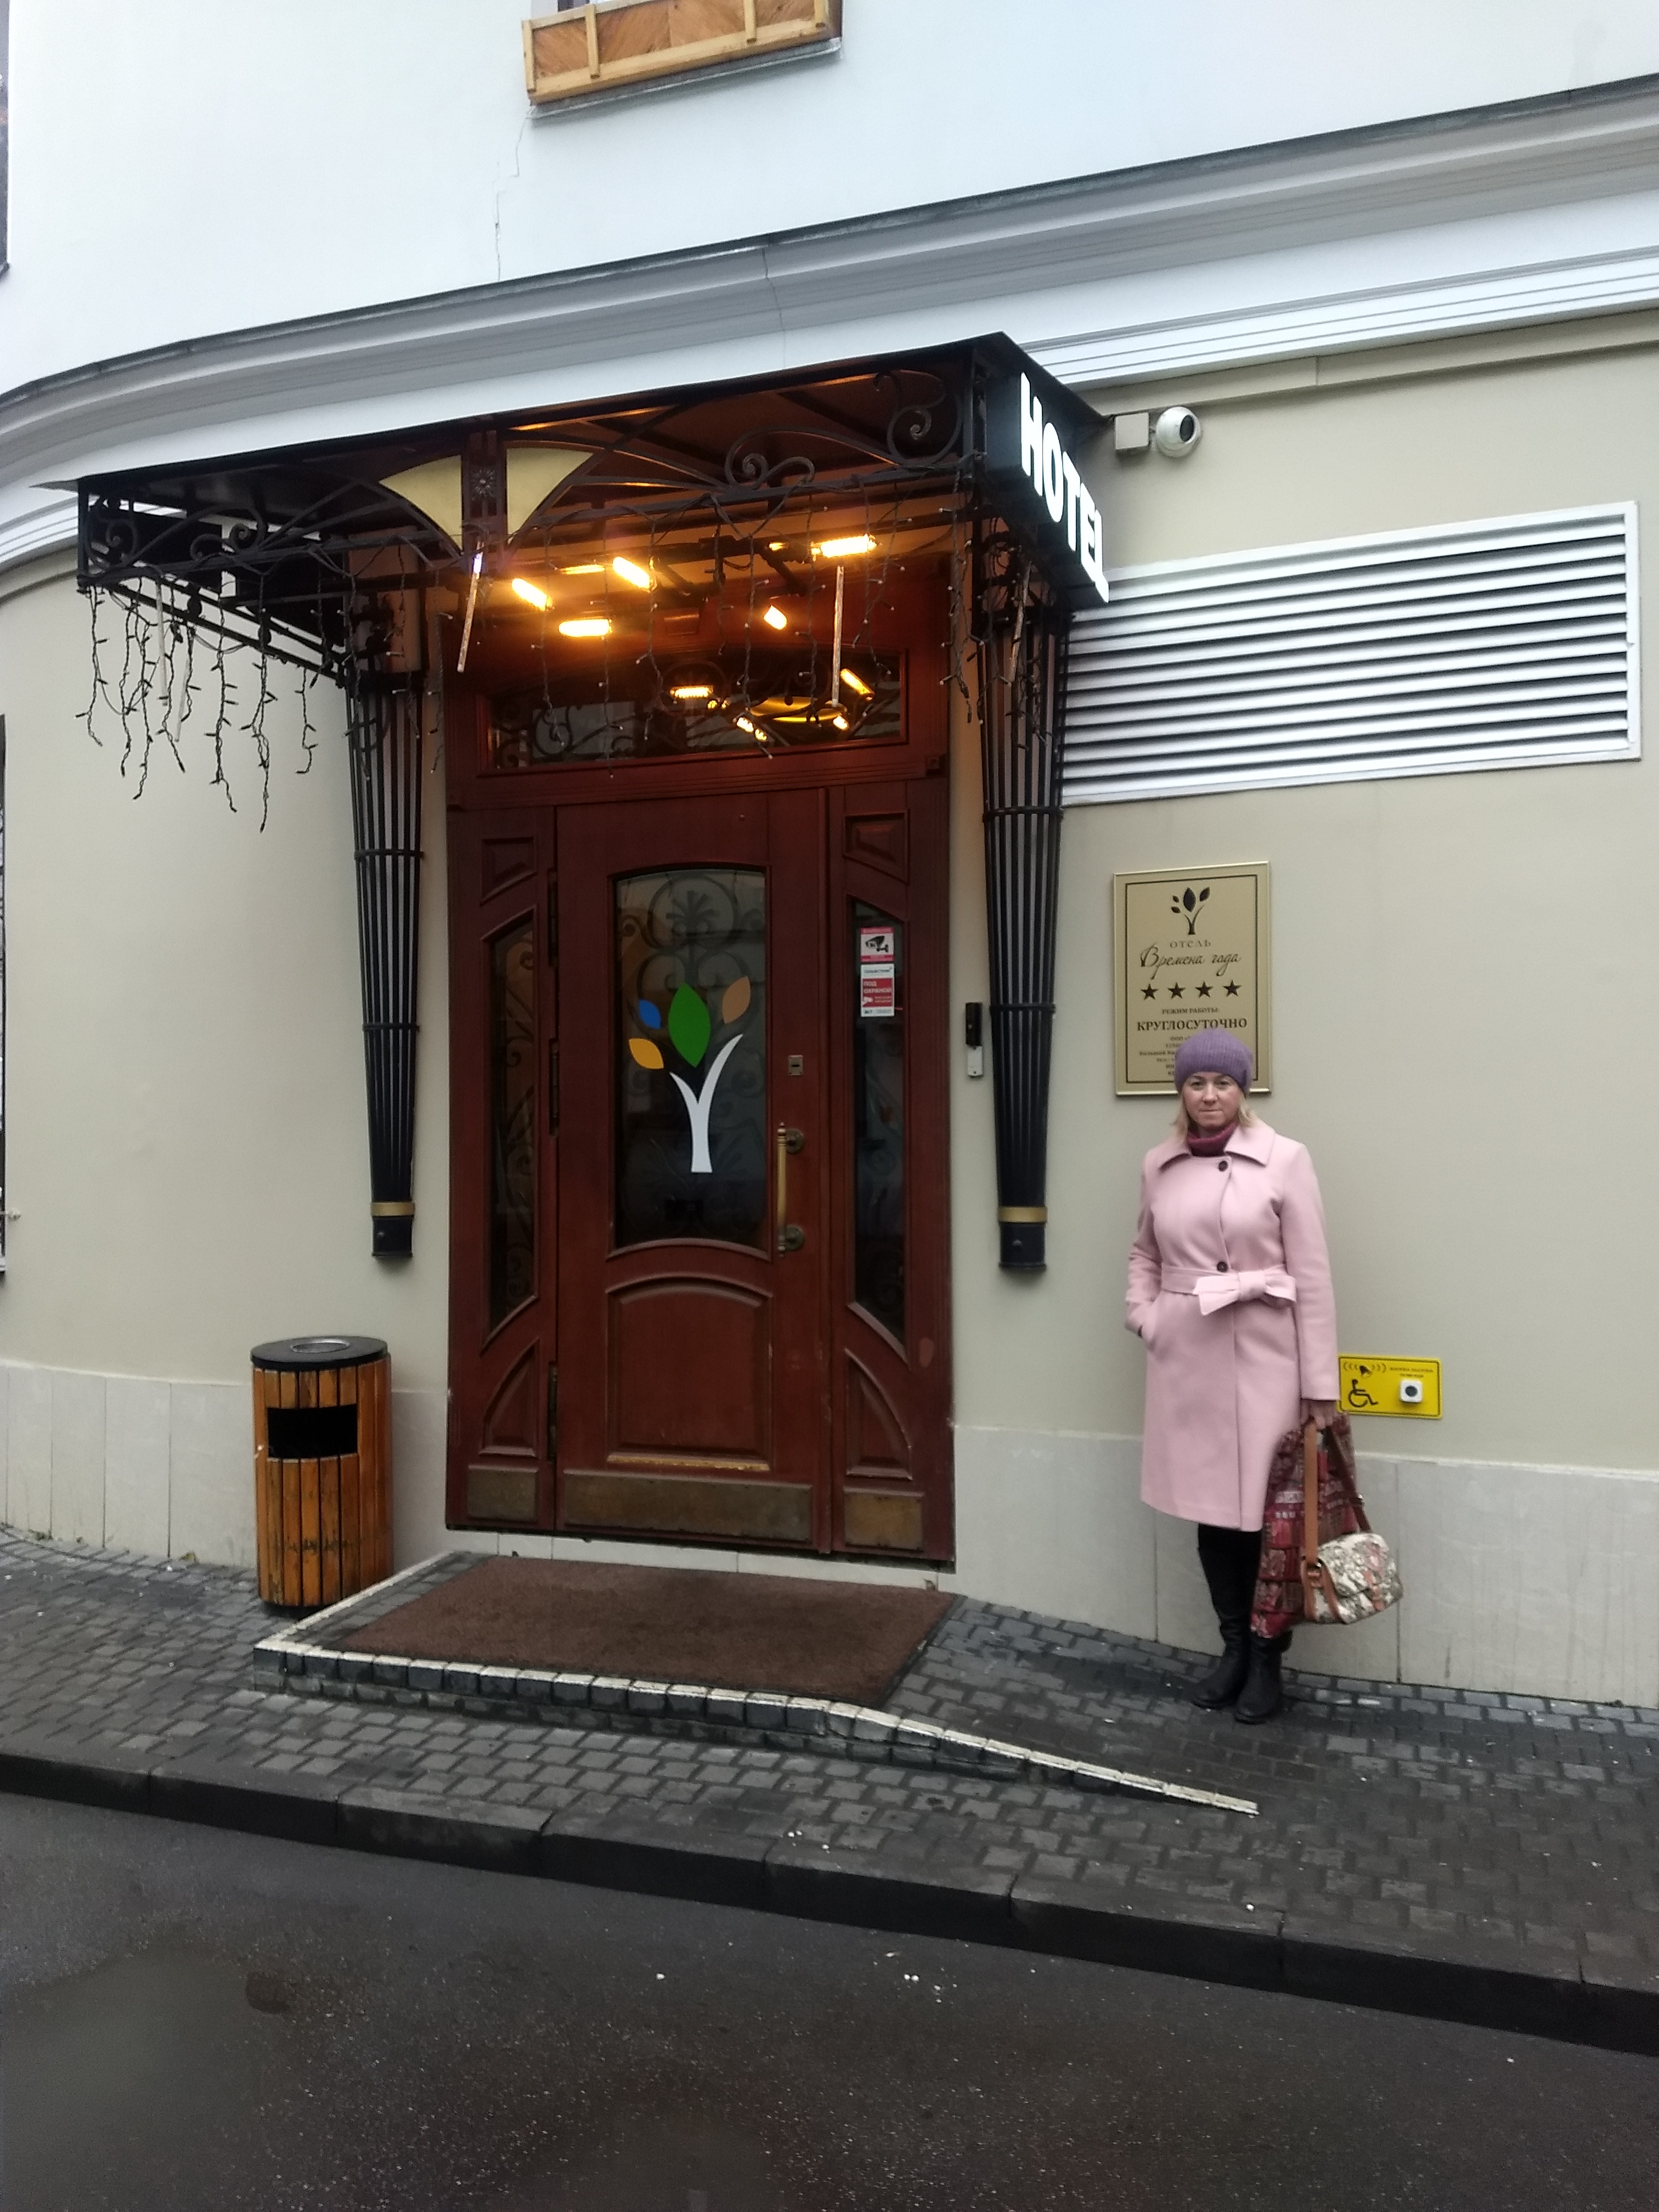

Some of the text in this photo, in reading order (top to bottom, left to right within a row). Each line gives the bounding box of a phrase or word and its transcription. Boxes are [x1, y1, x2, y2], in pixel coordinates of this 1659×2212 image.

[1020, 371, 1109, 603] HOTEL
[1140, 942, 1242, 980] Времена года
[1137, 1017, 1248, 1031] КРУГЛОСУТОЧНО
